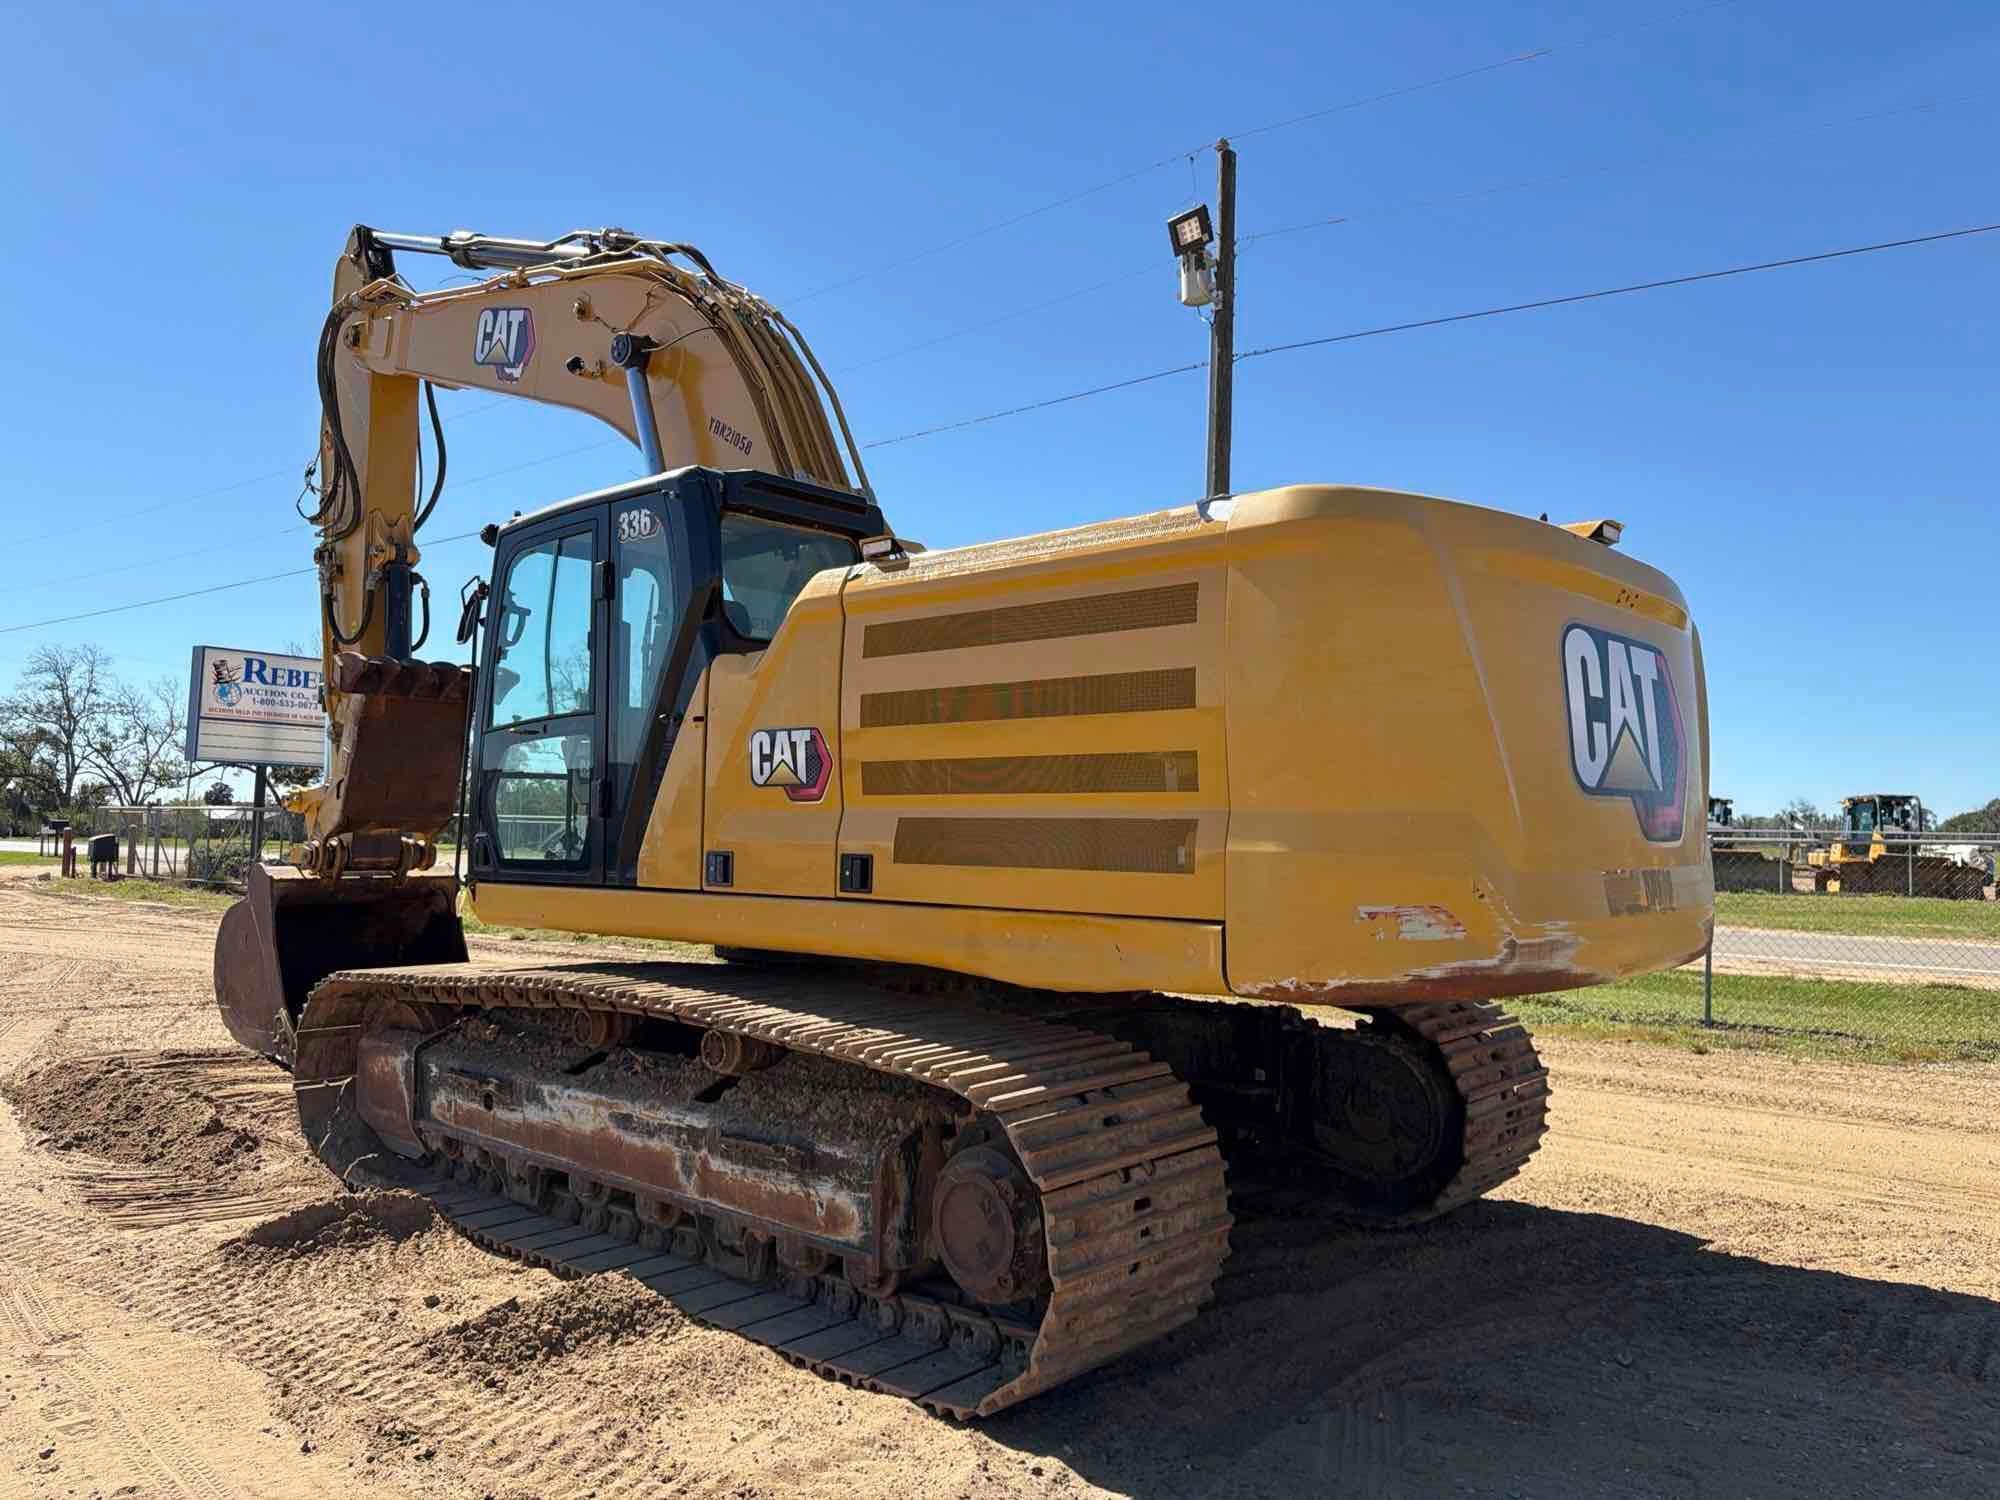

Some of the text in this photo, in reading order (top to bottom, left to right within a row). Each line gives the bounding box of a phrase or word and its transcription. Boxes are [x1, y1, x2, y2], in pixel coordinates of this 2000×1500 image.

[475, 309, 525, 363] CAT
[618, 508, 651, 541] 336
[241, 657, 322, 689] REBE
[243, 687, 288, 698] AUCTION
[1564, 627, 1664, 792] CAT
[751, 729, 811, 785] CAT
